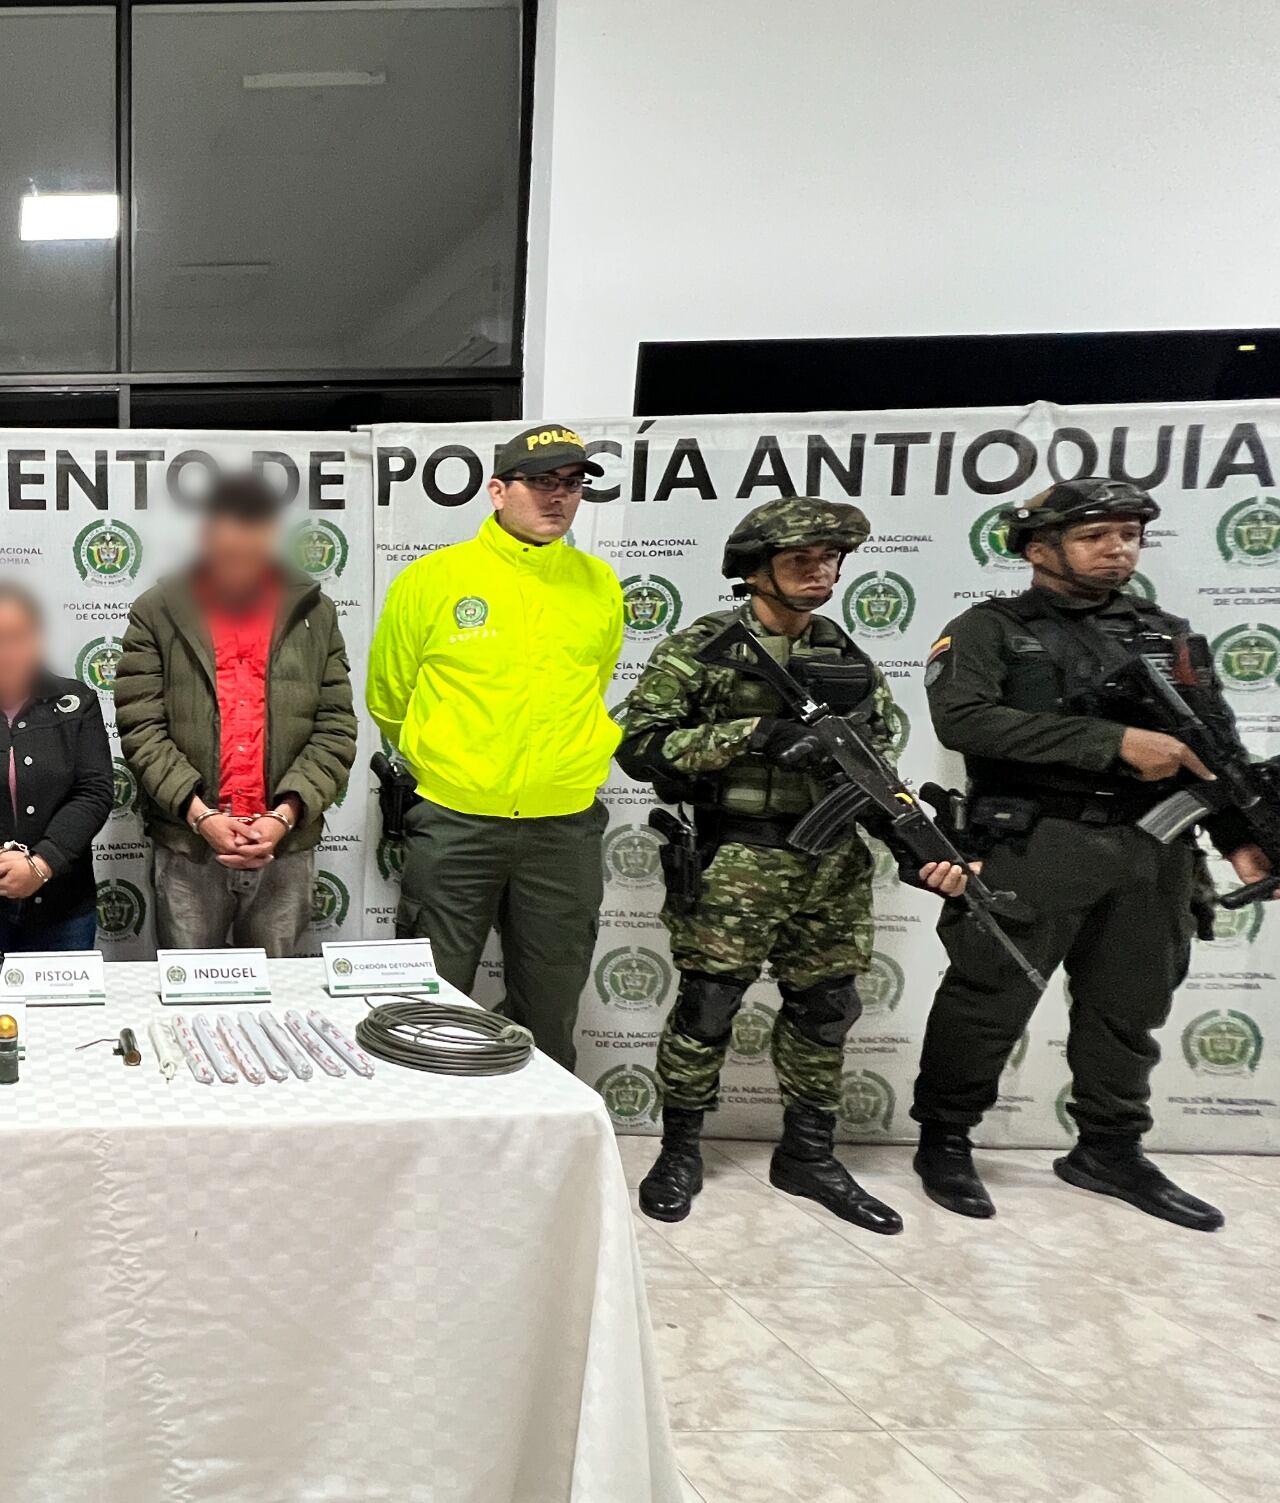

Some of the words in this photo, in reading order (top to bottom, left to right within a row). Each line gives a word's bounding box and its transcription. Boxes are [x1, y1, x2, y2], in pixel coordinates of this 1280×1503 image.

[252, 449, 346, 510] DE
[376, 419, 718, 507] POCÍA
[736, 422, 1276, 499] ANTIOQUIA
[598, 538, 638, 548] POLICÍA
[641, 539, 698, 547] NACIONAL
[877, 535, 933, 543] NACIONAL
[610, 550, 624, 558] DE
[626, 550, 684, 558] COLOMBIA
[863, 546, 919, 554] COLOMBIA
[76, 612, 88, 620] DE
[874, 660, 926, 668] ACIONAL
[108, 842, 151, 850] NACIONA
[95, 853, 145, 861] COLOMBIA
[353, 962, 387, 970] CORDÓN
[35, 970, 90, 982] PISTOLA
[194, 967, 257, 979] INDUGEL
